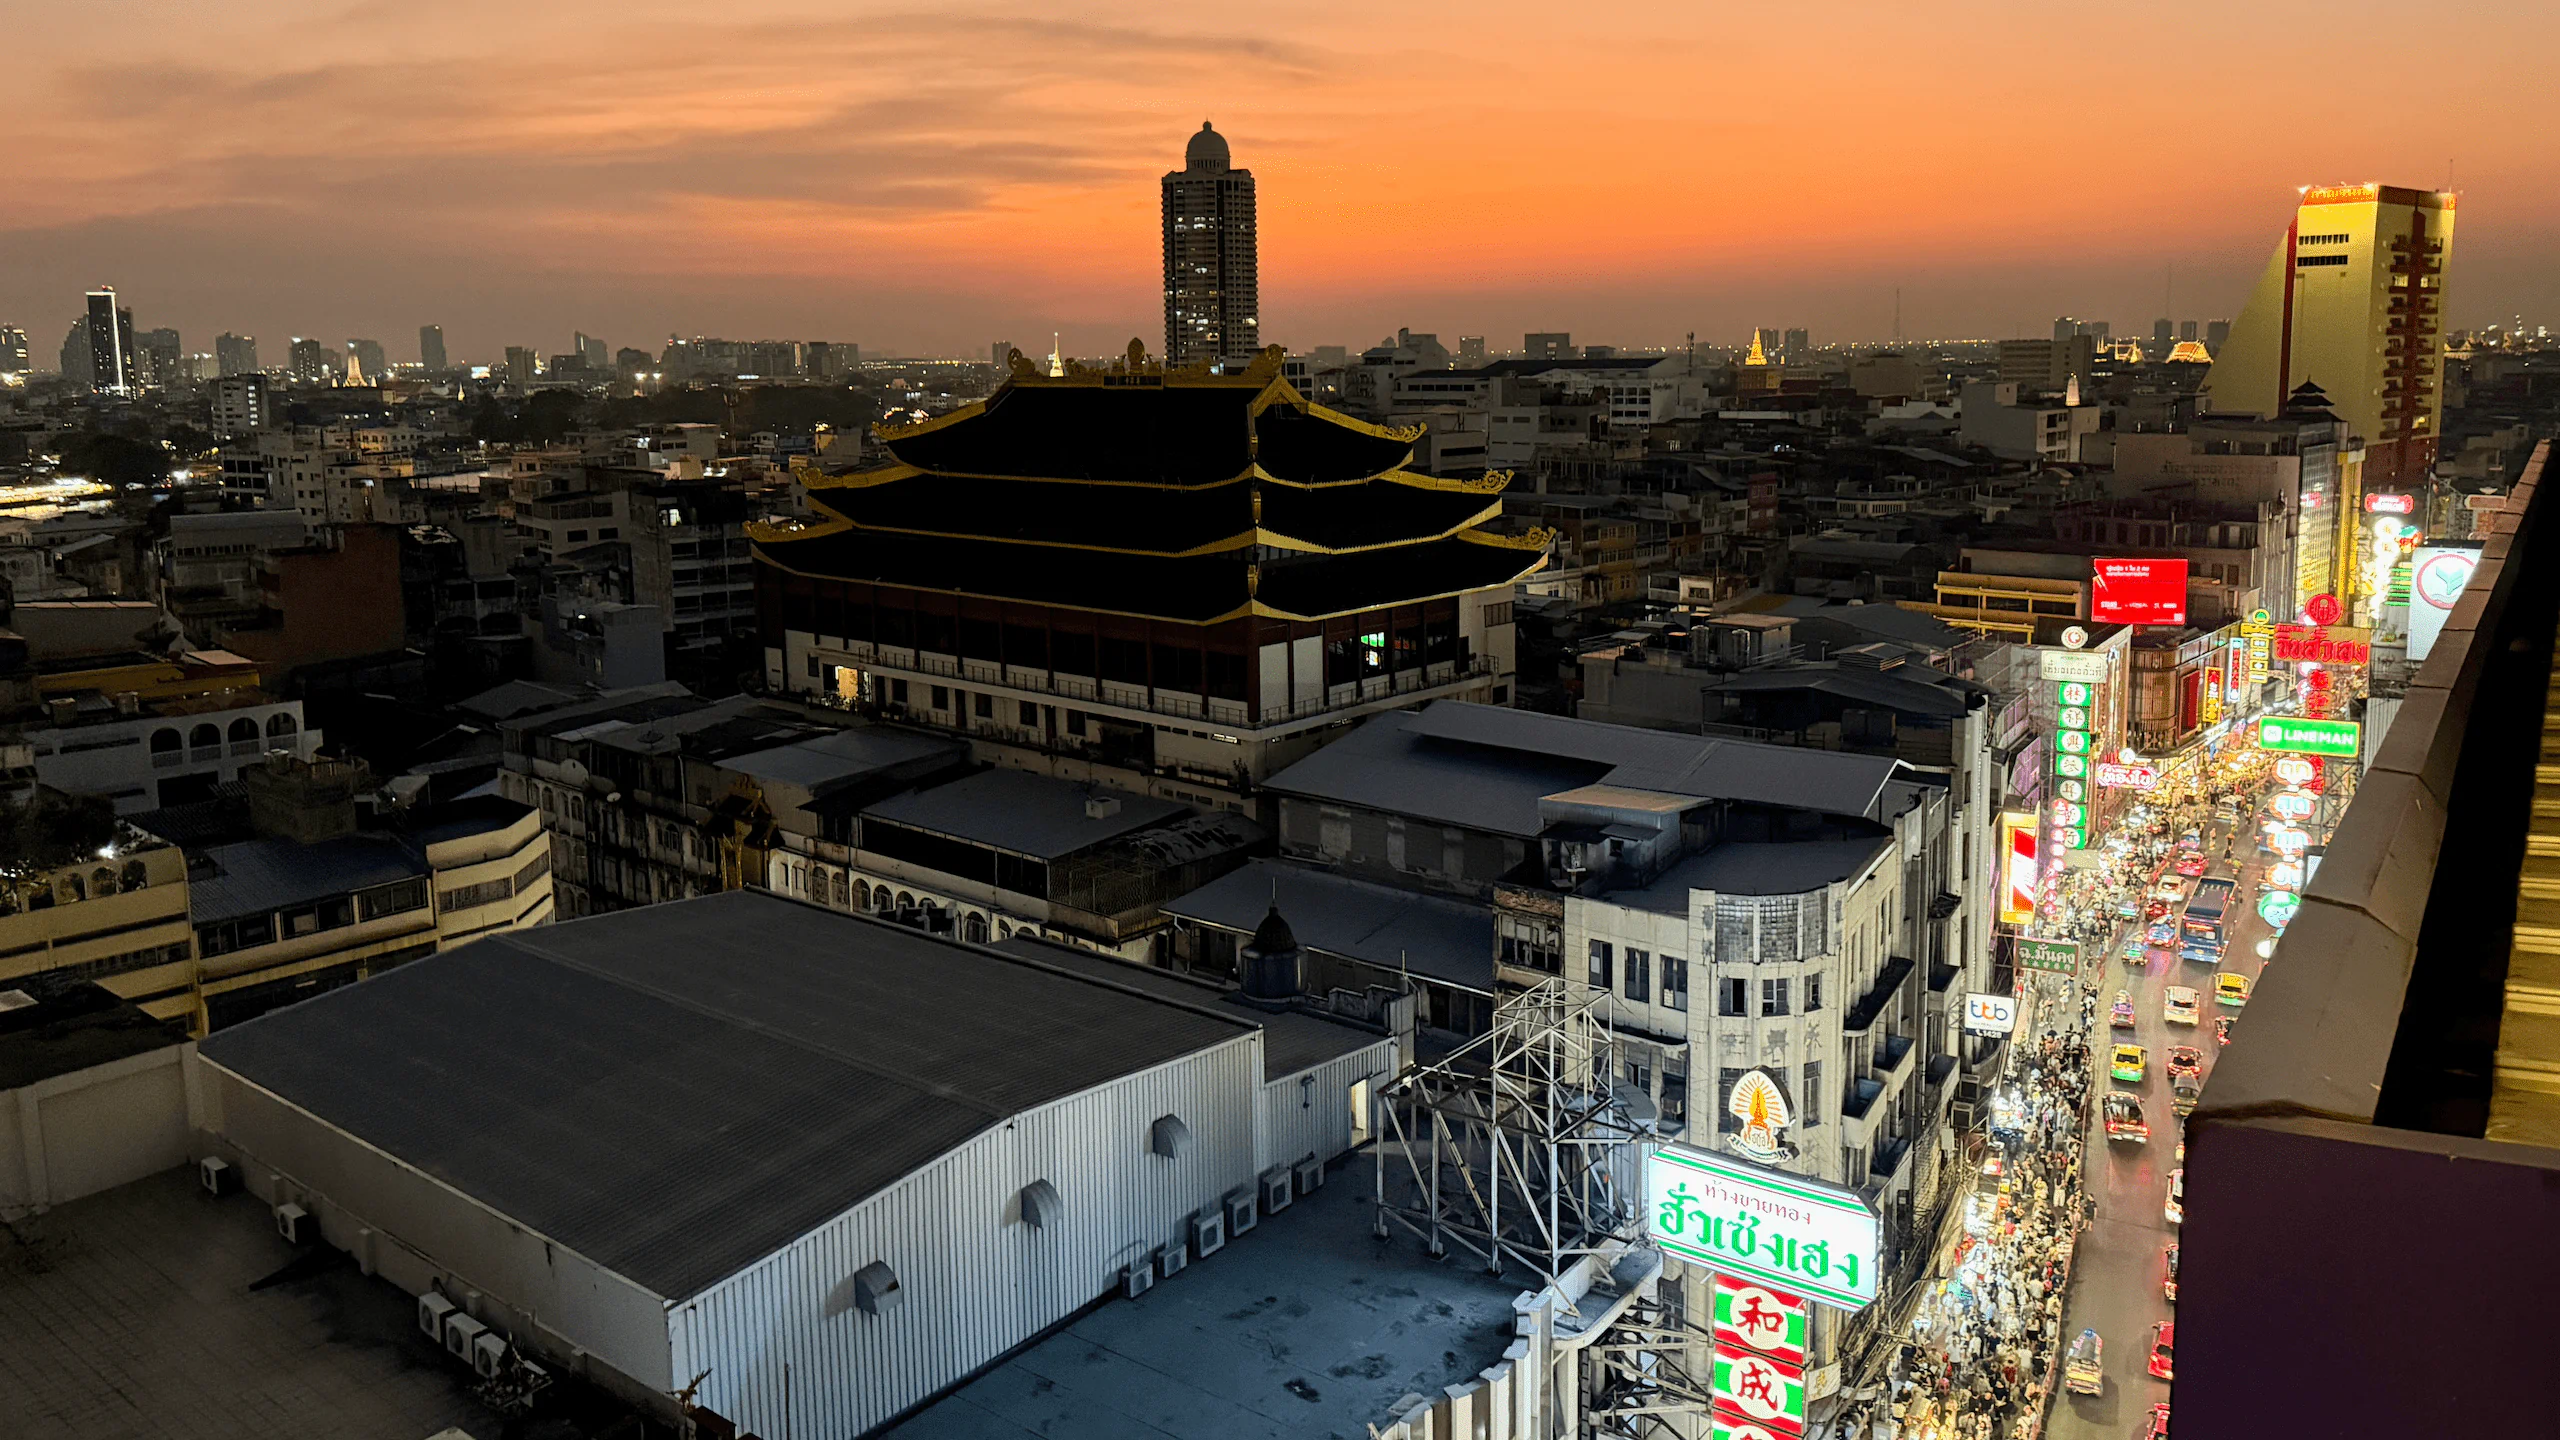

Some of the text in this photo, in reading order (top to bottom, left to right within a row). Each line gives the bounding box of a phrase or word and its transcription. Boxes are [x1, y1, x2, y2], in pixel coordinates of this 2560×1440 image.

[1970, 1000, 2008, 1021] ttb
[1658, 1181, 1859, 1289] ฮั่วเซ่งเฮง
[1704, 1179, 1812, 1225] ห้างขายทอง
[1735, 1296, 1785, 1440] 和成
